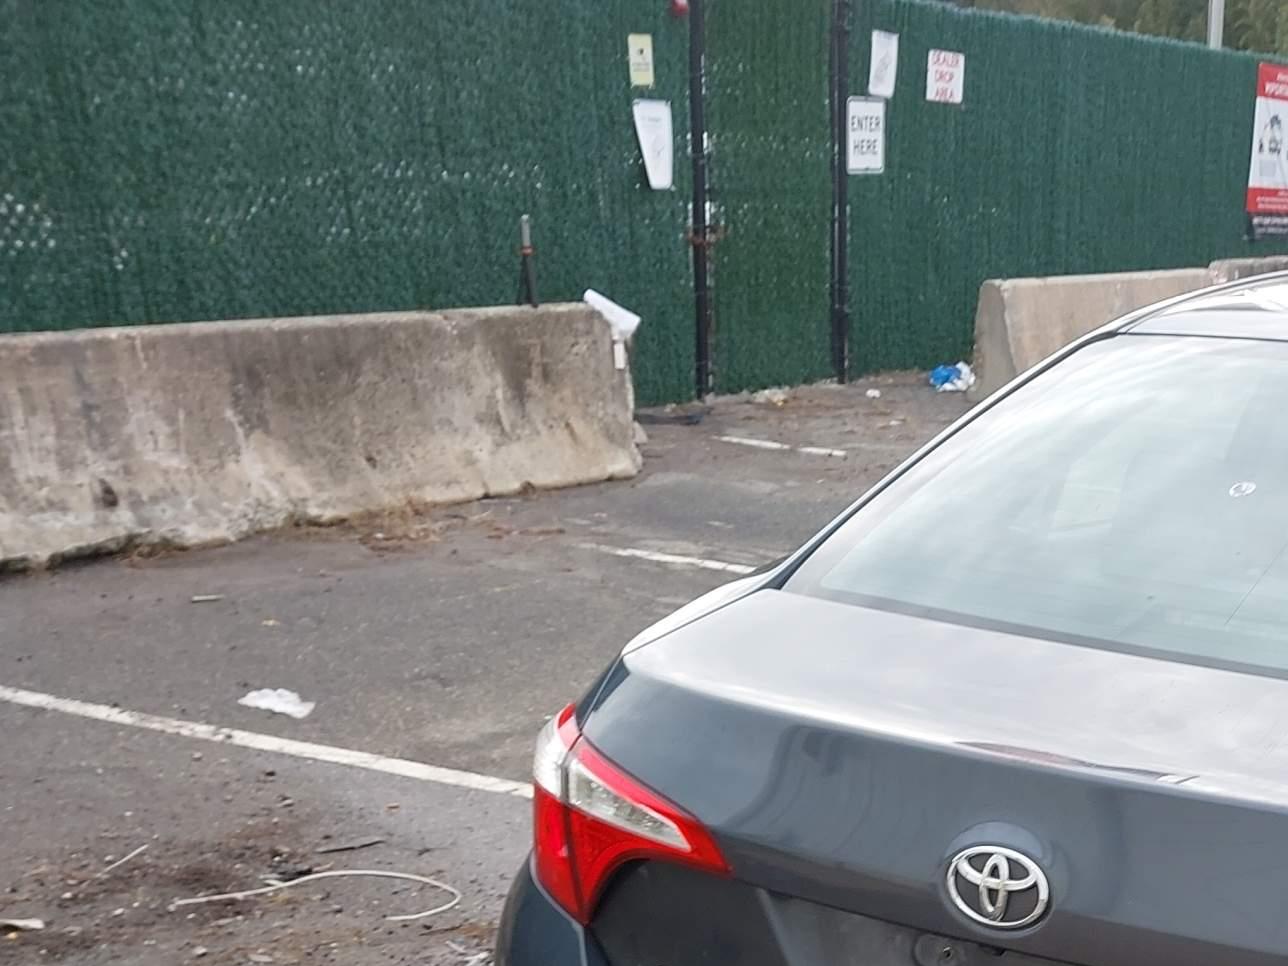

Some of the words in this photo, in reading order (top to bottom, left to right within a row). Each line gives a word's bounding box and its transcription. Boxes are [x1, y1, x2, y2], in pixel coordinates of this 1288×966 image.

[932, 51, 960, 67] DEALER
[934, 70, 955, 83] DROP
[935, 88, 954, 101] AREA
[851, 115, 881, 132] ENTER
[852, 138, 879, 156] HERE
